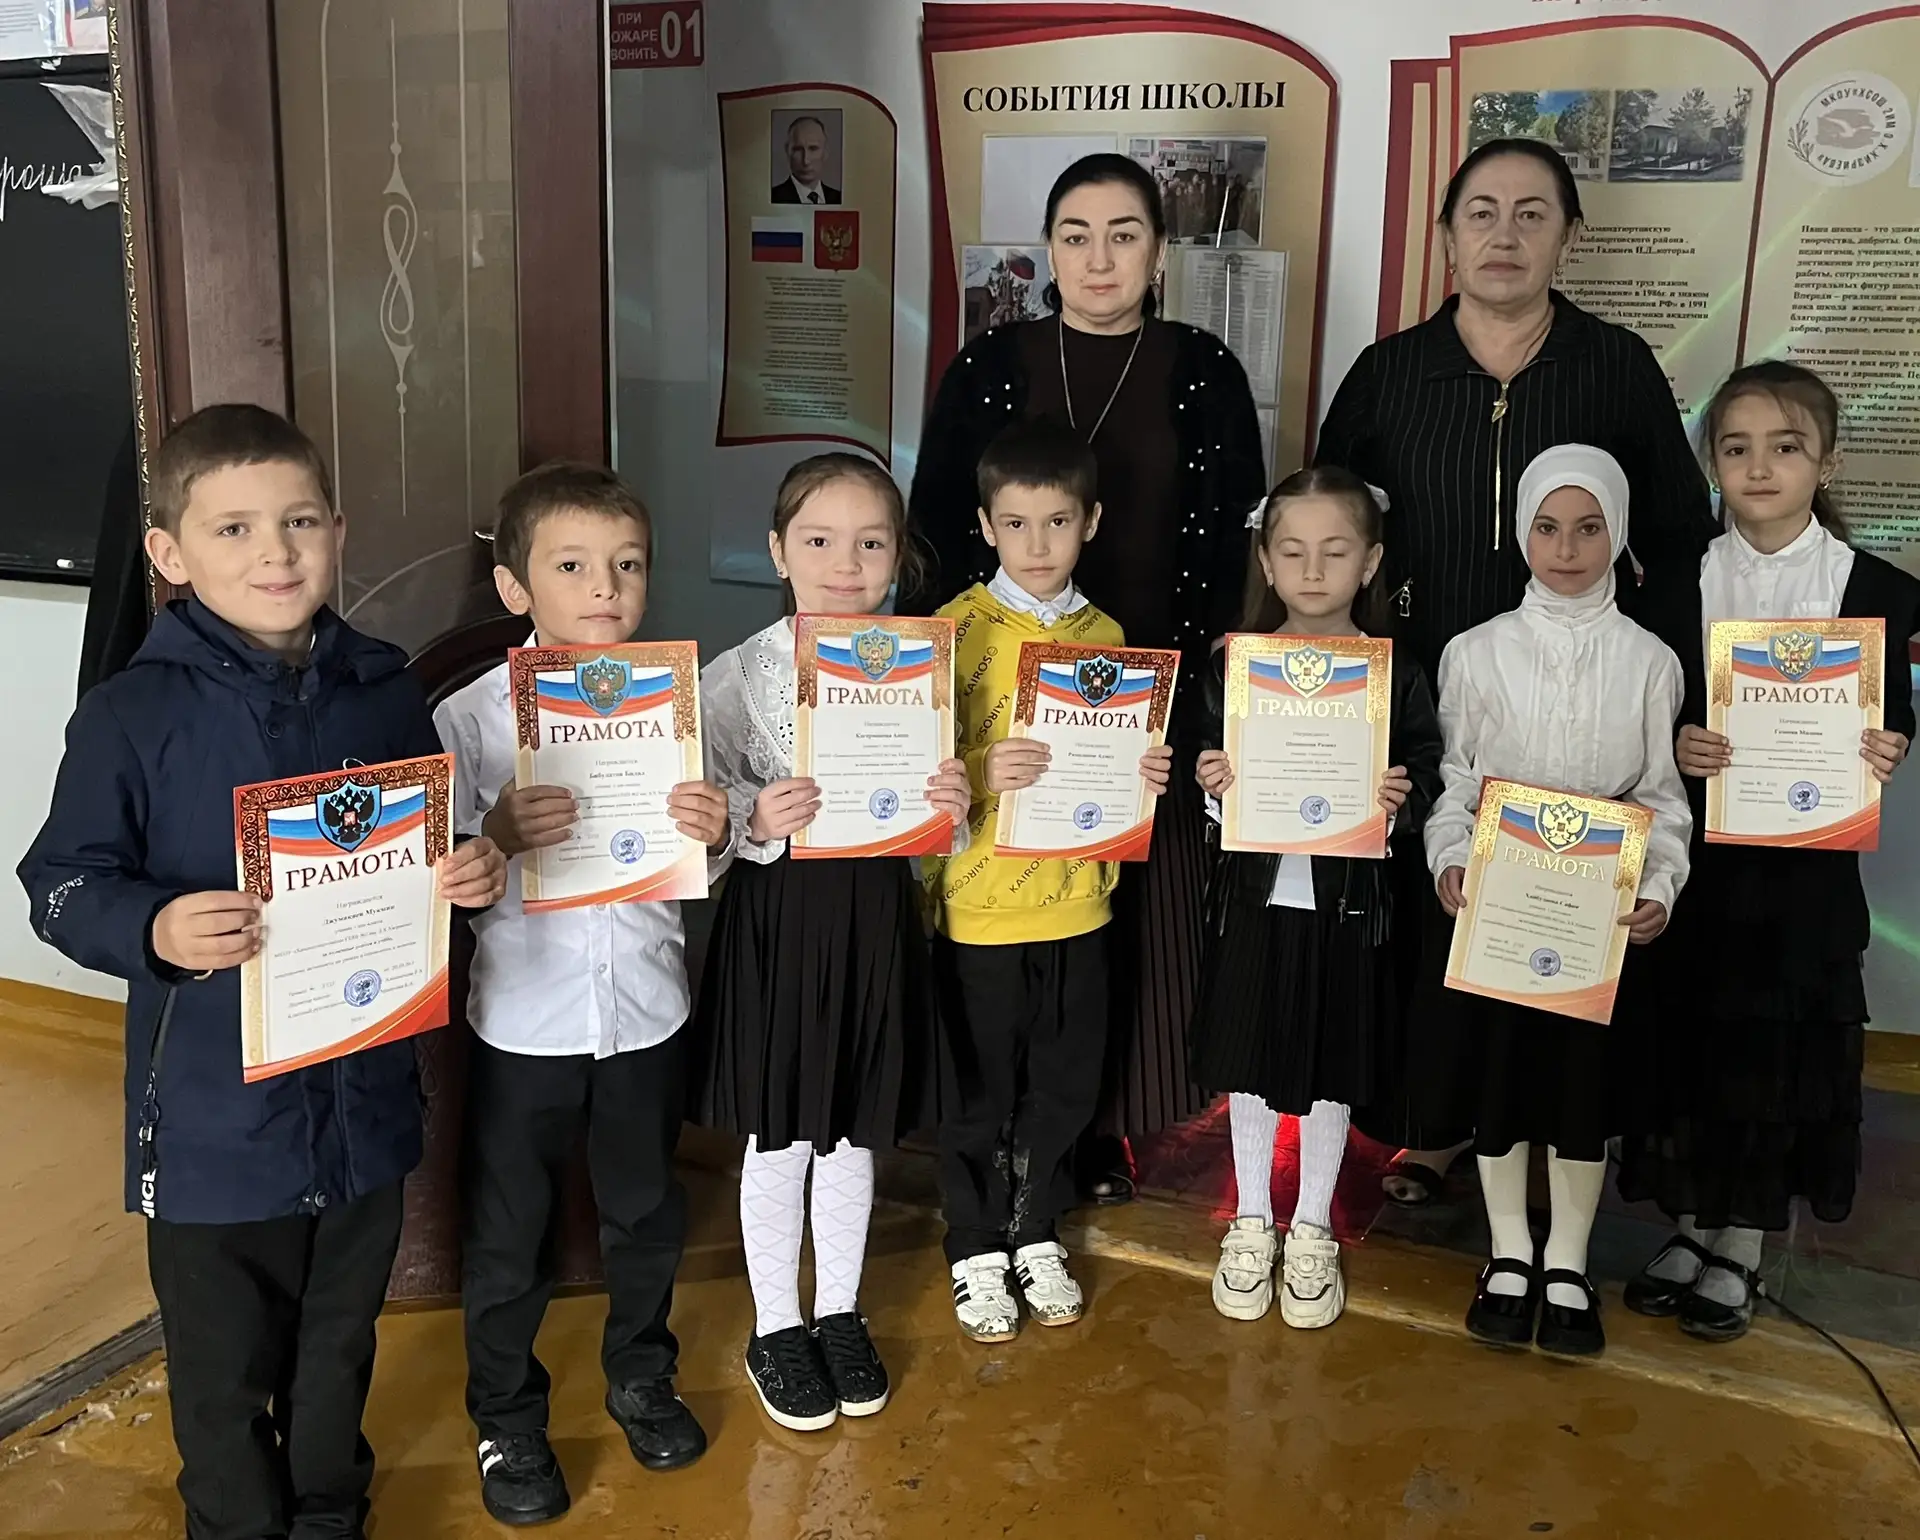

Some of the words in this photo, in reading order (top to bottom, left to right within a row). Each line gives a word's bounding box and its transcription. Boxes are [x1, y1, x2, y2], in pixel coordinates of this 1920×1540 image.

[618, 12, 642, 25] ПРИ
[611, 29, 658, 43] ОЖАРЕ
[661, 8, 701, 59] 01
[611, 47, 659, 61] ВОНИТЬ
[963, 84, 1131, 113] СОБЫТИЯ
[1140, 81, 1286, 111] ШКОЛЫ
[1801, 225, 1829, 233] Наша
[1857, 249, 1913, 257] учениками,
[1795, 270, 1833, 279] работы,
[1793, 291, 1832, 301] Впереди
[1860, 282, 1890, 291] фигур
[1790, 313, 1847, 323] благородное
[1787, 346, 1826, 355] Учителя
[1829, 347, 1860, 355] нашей
[964, 655, 993, 698] KAIROS
[826, 687, 925, 706] ГРАМОТА
[1742, 686, 1850, 705] ГРАМОТА
[979, 693, 1010, 735] KAIROS
[1256, 698, 1359, 719] ГРАМОТА
[1044, 708, 1140, 729] ГРАМОТА
[550, 720, 664, 744] ГРАМОТА
[285, 847, 416, 892] ГРАМОТА
[1503, 846, 1606, 882] ГРАМОТА
